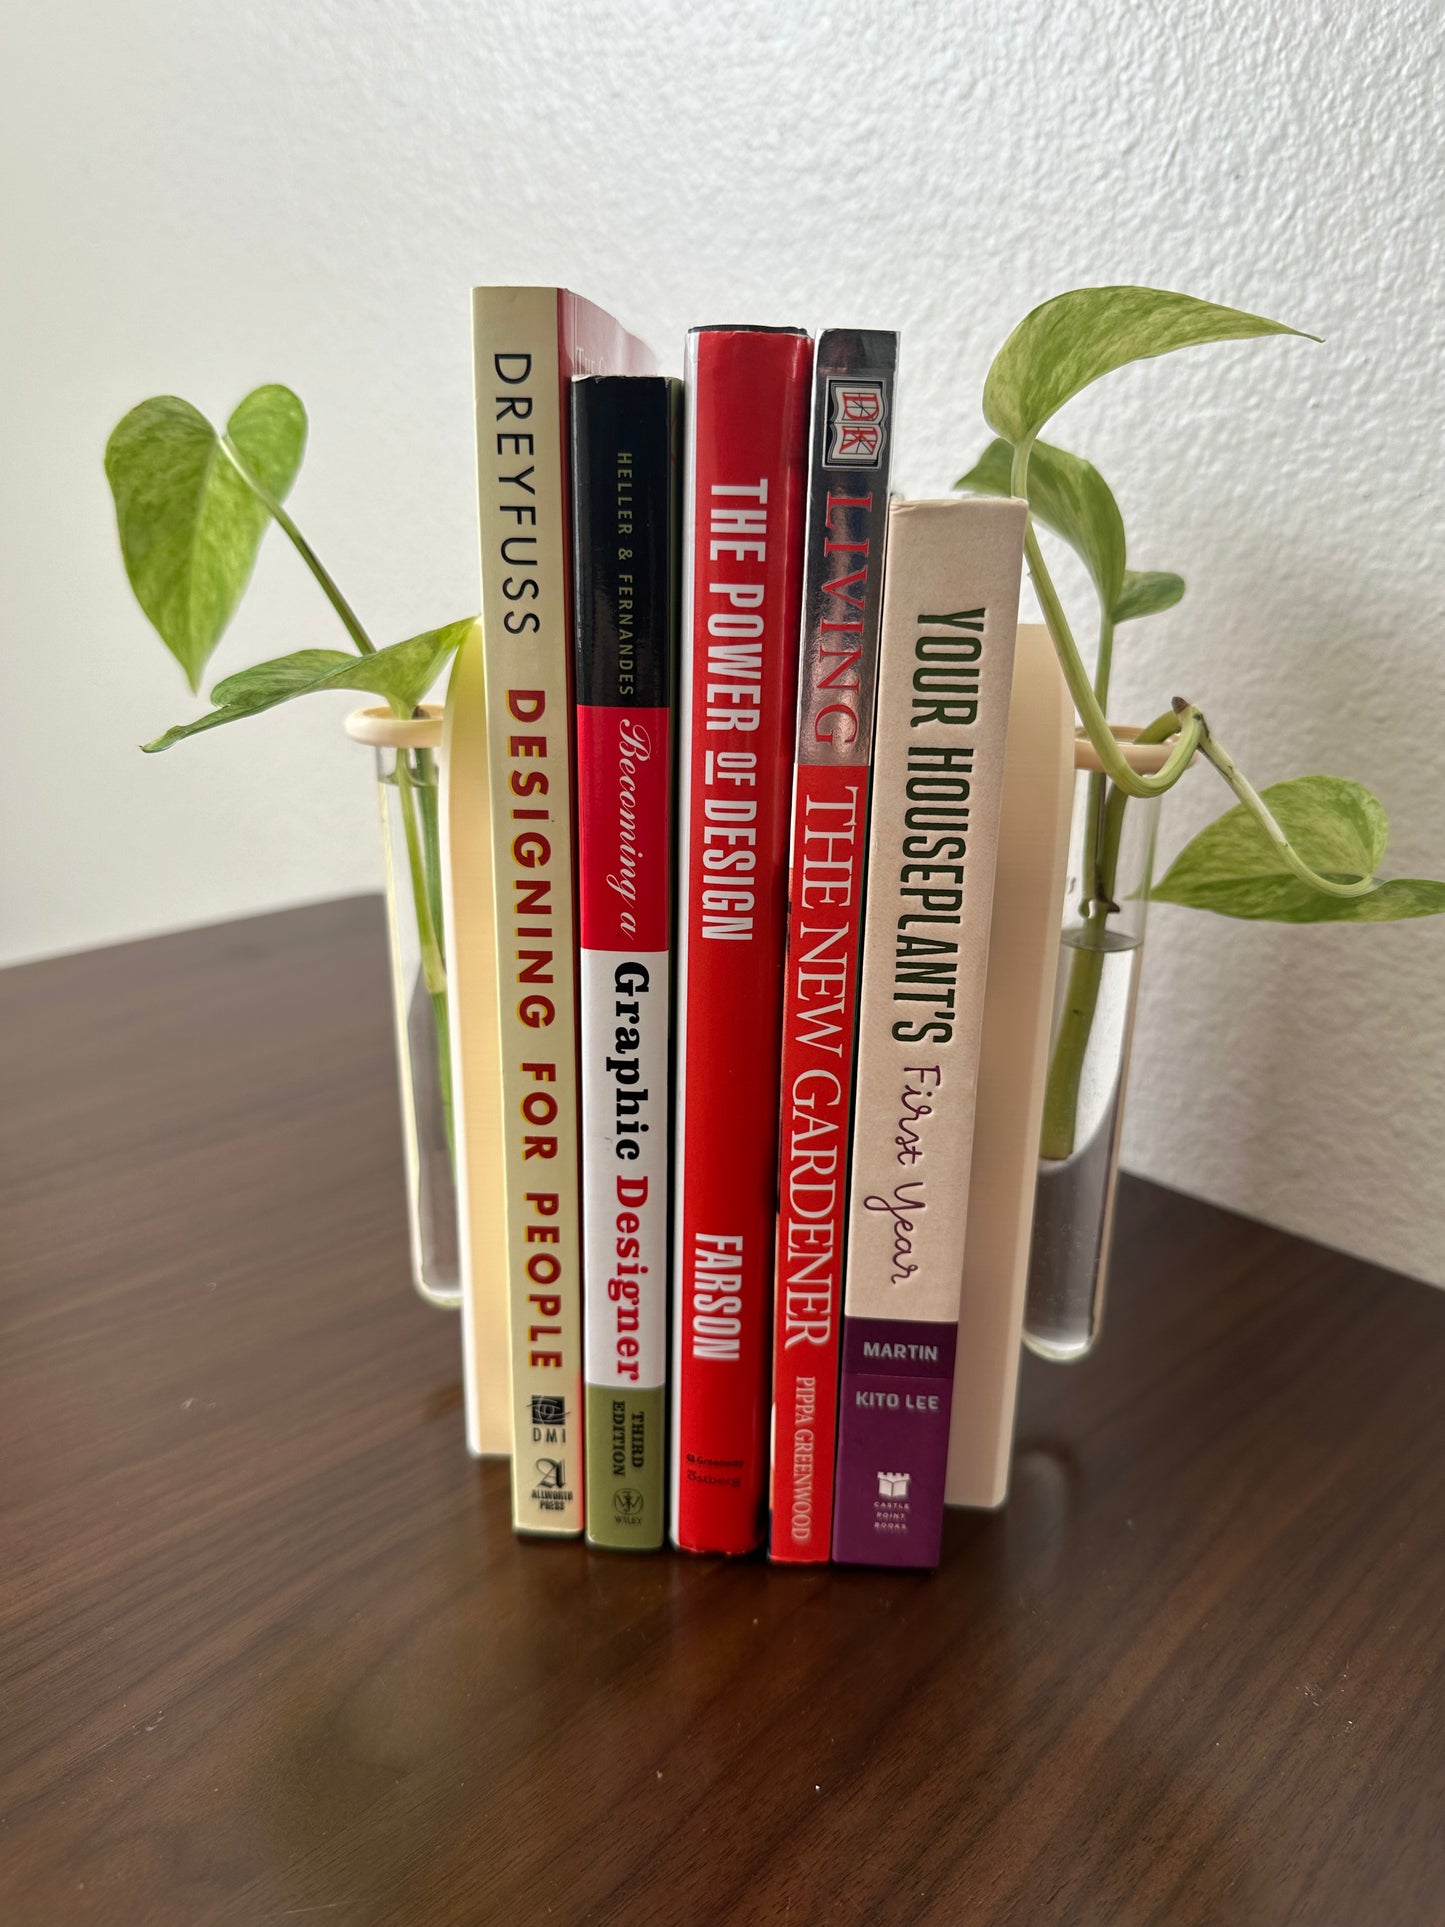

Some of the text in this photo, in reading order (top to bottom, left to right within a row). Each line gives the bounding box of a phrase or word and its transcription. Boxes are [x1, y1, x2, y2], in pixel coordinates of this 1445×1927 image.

[493, 353, 540, 635] DREYFUSS
[832, 394, 882, 458] DK
[616, 452, 635, 696] HELLER & FERNANDES
[703, 478, 769, 943] THE POWER OF DESIGN
[606, 717, 652, 941] Becoming a
[784, 491, 872, 1349] LIVING THE NEW GARDENER
[891, 607, 986, 1044] YOUR HOUSEPLANT'S
[507, 690, 563, 1370] DESIGNING FOR PEOPLE
[606, 960, 650, 1382] Graphic Designer
[864, 1065, 941, 1286] First Year
[692, 1232, 743, 1362] FARSON
[855, 1391, 939, 1411] KITO LEE
[863, 1341, 938, 1361] MARTIN
[532, 1427, 567, 1444] DMI
[612, 1400, 626, 1477] EDITION
[631, 1411, 645, 1469] THIRD
[791, 1376, 815, 1540] PIPPA GREENWOOD
